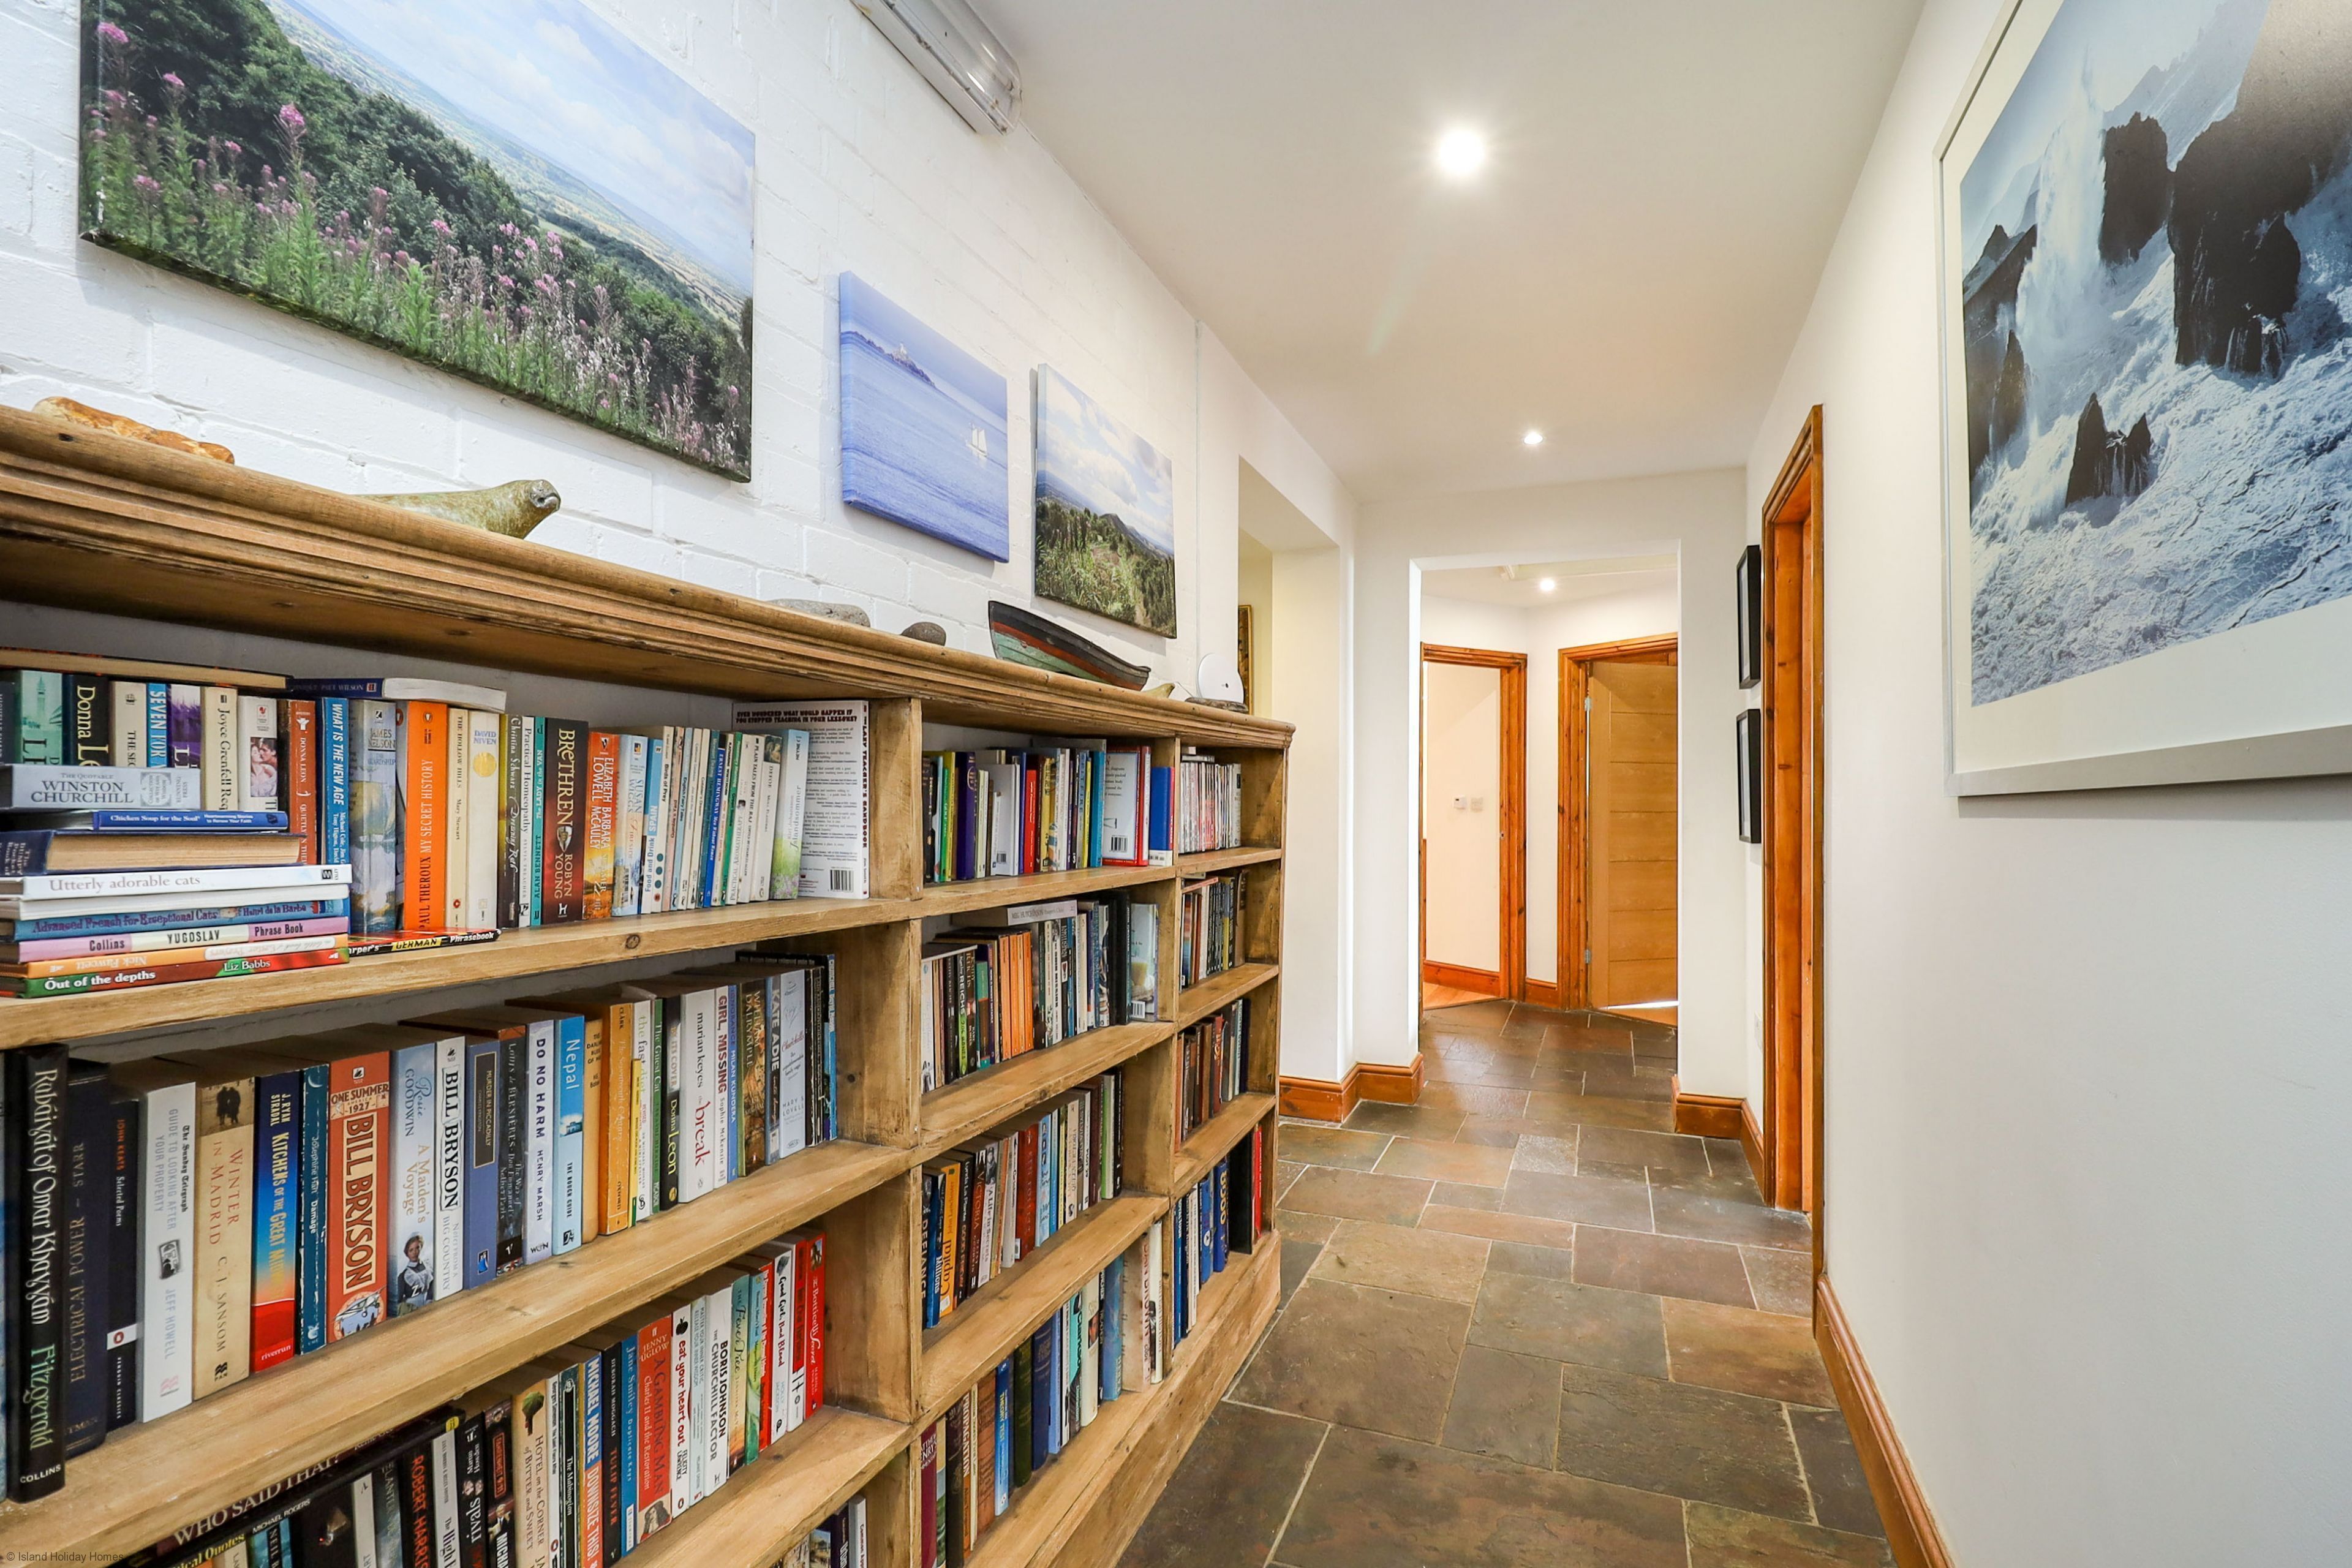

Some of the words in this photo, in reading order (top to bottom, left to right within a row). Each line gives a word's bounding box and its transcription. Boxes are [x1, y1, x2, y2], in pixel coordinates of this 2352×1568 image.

[77, 685, 96, 739] Donna
[218, 708, 230, 739] Joyce
[332, 703, 342, 731] WHAT
[127, 731, 136, 749] THE
[333, 732, 343, 741] IS
[368, 739, 396, 748] NELSON
[370, 728, 392, 739] JAMES
[221, 741, 232, 785] Grenfell
[333, 744, 343, 762] THE
[42, 780, 124, 793] WINSTON
[333, 763, 344, 785] NEW
[422, 760, 434, 799] HISTORY
[592, 757, 604, 802] LOWELL
[603, 758, 614, 803] ELIZABETH
[31, 793, 134, 804] CHURCHILL
[333, 786, 344, 805] AGE
[634, 780, 644, 813] SUSAN
[420, 802, 433, 837] SECRET
[590, 806, 601, 850] McCAULEY
[601, 806, 612, 849] BARBARA
[649, 805, 658, 832] SPAIN
[420, 839, 432, 853] MY
[49, 877, 105, 893] Utterly
[111, 875, 173, 889] adorable
[175, 876, 201, 886] cats
[419, 857, 431, 902] THEROUX
[554, 853, 564, 899] YOUNG
[564, 854, 573, 897] ROBYN
[419, 906, 431, 929] PAUL
[89, 939, 126, 952] Collins
[167, 930, 221, 944] YUGOSLAV
[254, 925, 282, 937] Phrase
[285, 923, 304, 934] Book
[396, 939, 437, 949] GERMAN
[449, 931, 495, 943] Phrasebook
[75, 957, 121, 970] Fawcett
[123, 956, 148, 966] Nick
[224, 962, 238, 972] Liz
[241, 960, 271, 970] Babbs
[45, 978, 70, 990] Out
[74, 976, 88, 987] of
[91, 974, 112, 986] the
[115, 970, 156, 984] depths
[717, 995, 728, 1031] GIRL,
[771, 989, 780, 1028] KATE
[536, 1038, 546, 1059] DO
[562, 1038, 581, 1090] Nepal
[717, 1034, 728, 1095] MISSING
[771, 1033, 780, 1072] ADIE
[536, 1065, 546, 1086] NO
[270, 1094, 281, 1127] STRADAL
[331, 1091, 350, 1105] ONE
[350, 1083, 390, 1101] SUMMER
[404, 1068, 415, 1137] GOODWIN
[445, 1070, 459, 1118] BILL
[168, 1109, 179, 1137] GUIDE
[281, 1102, 292, 1124] RYAN
[536, 1092, 545, 1139] HARM
[154, 1134, 165, 1161] YOUR
[168, 1141, 178, 1152] TO
[181, 1143, 190, 1174] Sunday
[213, 1141, 222, 1157] IN
[271, 1132, 290, 1186] KITCHENS
[310, 1136, 319, 1175] Josephine
[345, 1114, 374, 1177] BILL
[418, 1144, 431, 1156] A
[26, 1154, 56, 1174] of
[167, 1156, 178, 1197] LOOKING
[444, 1124, 459, 1209] BRYSON
[32, 1176, 56, 1228] Omar
[154, 1164, 165, 1212] PROPERTY
[179, 1175, 189, 1213] Telegraph
[227, 1148, 243, 1226] WINTER
[273, 1197, 285, 1212] THE
[274, 1187, 285, 1197] OF
[402, 1161, 417, 1216] Voyage
[417, 1158, 431, 1224] Maiden's
[973, 1170, 985, 1230] VICTORIA
[167, 1200, 176, 1231] AFTER
[209, 1165, 224, 1245] MADRID
[309, 1199, 318, 1235] Damage
[269, 1212, 287, 1246] GREAT
[345, 1172, 374, 1290] BRYSON
[921, 1219, 929, 1299] DEFIANCE
[934, 1255, 943, 1294] Millions
[939, 1239, 954, 1297] Capital
[25, 1231, 56, 1325] Khayyám
[165, 1289, 176, 1312] JEFF
[164, 1316, 176, 1360] HOWELL
[260, 1344, 292, 1361] riverrun
[643, 1333, 668, 1354] JENNY
[678, 1340, 687, 1360] eat
[675, 1360, 687, 1388] your
[720, 1340, 728, 1376] BORIS
[23, 1343, 56, 1451] Fitzgerald
[587, 1357, 600, 1416] MICHAEL
[677, 1389, 687, 1424] heart
[718, 1378, 728, 1438] JOHNSON
[524, 1446, 530, 1457] of
[587, 1412, 600, 1464] MOORE
[677, 1425, 686, 1447] out
[535, 1434, 544, 1476] HOTEL
[20, 1464, 62, 1484] COLLINS
[524, 1455, 533, 1497] BITTER
[536, 1484, 545, 1500] the
[587, 1466, 600, 1531] DOWNSIZE
[252, 1513, 283, 1534] MICHAEL
[284, 1498, 311, 1520] ROGERS
[466, 1497, 482, 1544] rivals
[526, 1510, 534, 1550] SWEET
[537, 1499, 546, 1546] CORNER
[587, 1528, 600, 1561] THIS!
